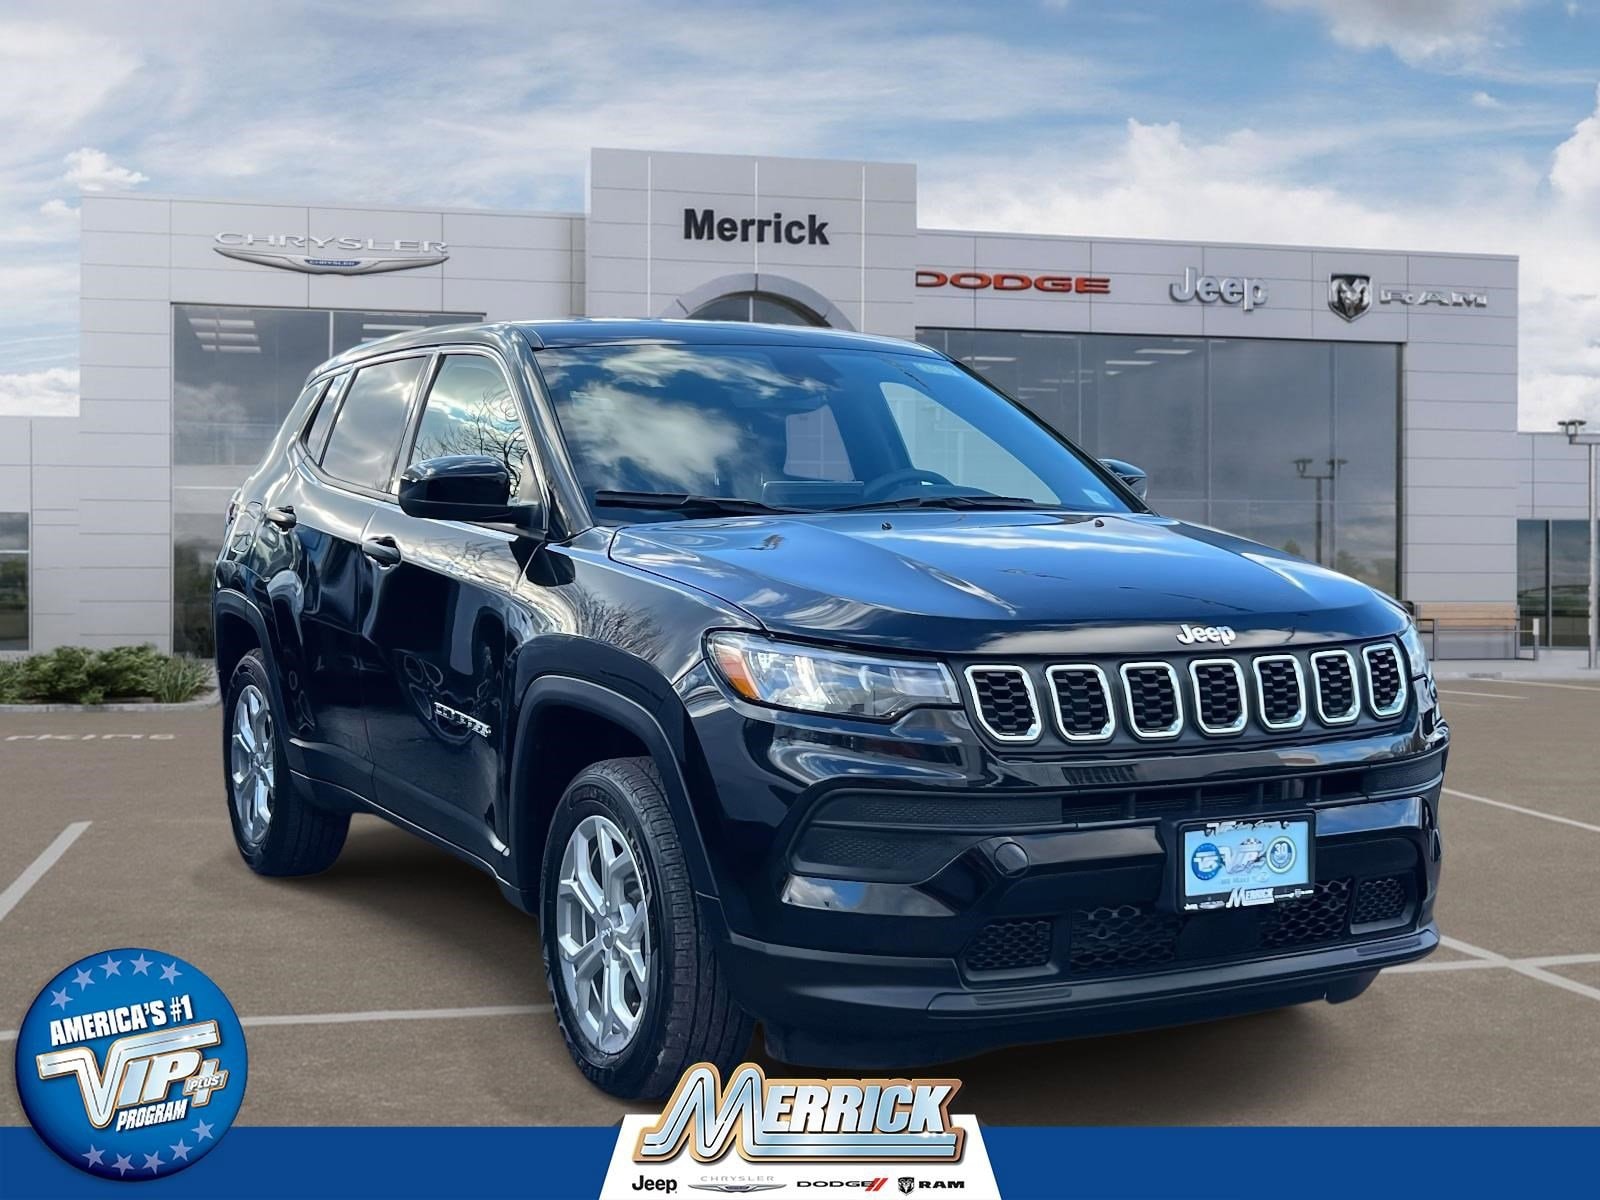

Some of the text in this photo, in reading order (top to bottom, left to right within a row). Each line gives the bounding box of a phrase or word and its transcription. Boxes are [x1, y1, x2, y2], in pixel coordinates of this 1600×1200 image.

[684, 208, 830, 245] Merrick
[215, 232, 449, 253] CHRYSLER
[915, 271, 1111, 294] DODGE
[1169, 266, 1268, 312] Jeep
[1380, 289, 1488, 308] RAM
[1176, 623, 1237, 646] Jeep
